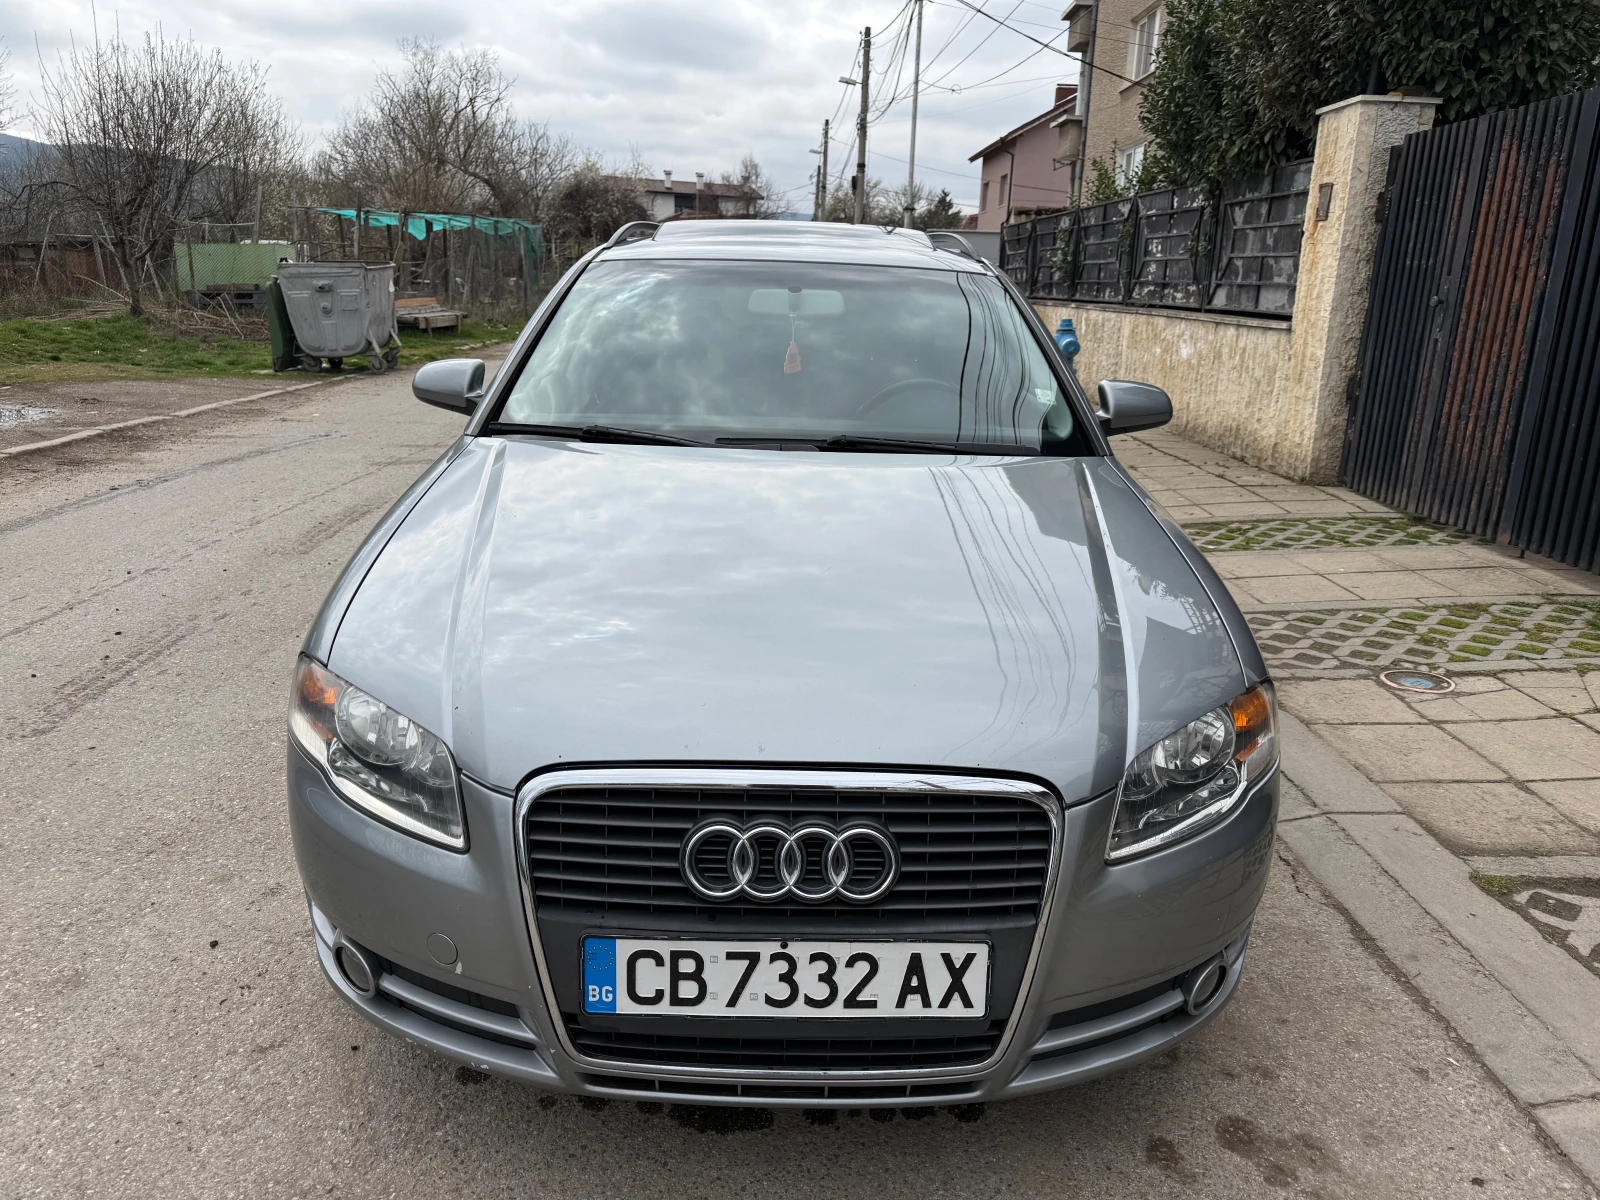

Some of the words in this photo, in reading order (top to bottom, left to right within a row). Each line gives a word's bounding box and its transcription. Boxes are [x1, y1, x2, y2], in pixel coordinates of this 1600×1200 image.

[588, 984, 614, 1002] BG
[626, 949, 708, 1007] CB
[725, 951, 878, 1009] 7332
[895, 952, 978, 1009] AX
